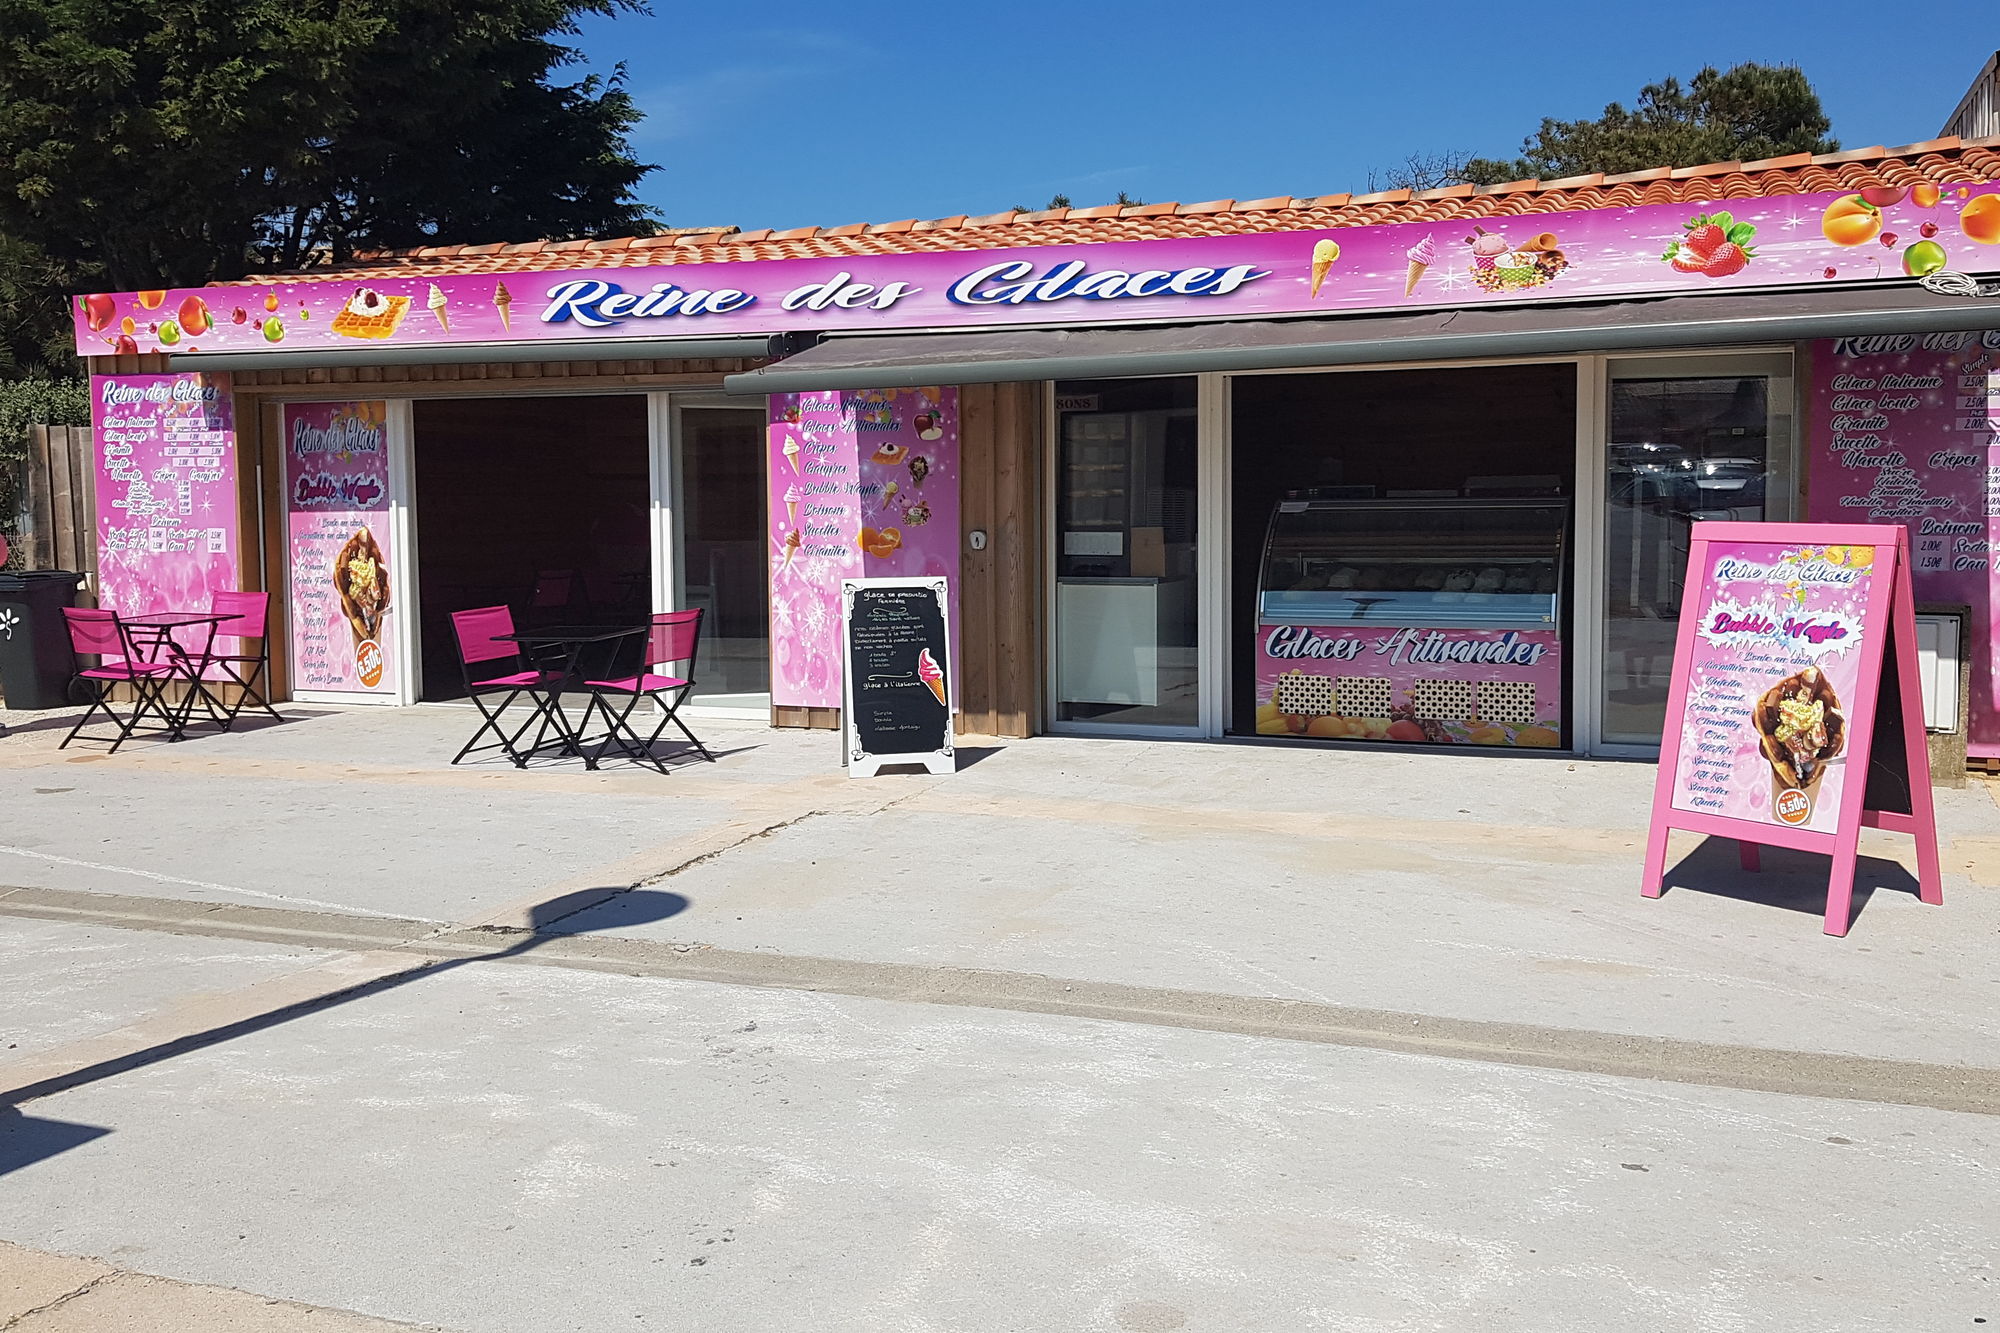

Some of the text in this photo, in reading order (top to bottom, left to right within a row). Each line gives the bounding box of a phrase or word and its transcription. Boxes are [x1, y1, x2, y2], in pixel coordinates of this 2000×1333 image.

[541, 260, 1273, 327] Reine des Glaces
[1832, 373, 1943, 391] Glace Italienne
[102, 380, 220, 405] Reine des Glaces
[803, 398, 837, 412] Glaces
[1832, 392, 1919, 410] Glace boule
[803, 419, 837, 433] Glaces
[1831, 415, 1888, 431] Granité
[294, 418, 323, 458] Reine
[1831, 433, 1880, 450] Sucette
[1843, 450, 1906, 469] Mascotte
[1928, 452, 1979, 469] Crêpes
[804, 481, 841, 496] Bubble
[1875, 477, 1919, 487] Nutella
[1869, 487, 1926, 498] Chantilly
[1841, 496, 1953, 508] Nutella Chantilly
[803, 503, 844, 517] Boissons
[1869, 507, 1922, 518] Confiture
[803, 522, 840, 536] Sucettes
[1919, 518, 1983, 536] Boissons
[1954, 538, 1990, 553] Soda
[1716, 559, 1859, 583] Reine des Glaces
[1954, 556, 1986, 571] Eau
[1710, 612, 1776, 634] Bubble
[1265, 625, 1549, 666] Glaces Artisanales
[1700, 691, 1746, 702] Caramel
[1696, 717, 1742, 732] Chantilly
[1705, 730, 1728, 740] Oreo
